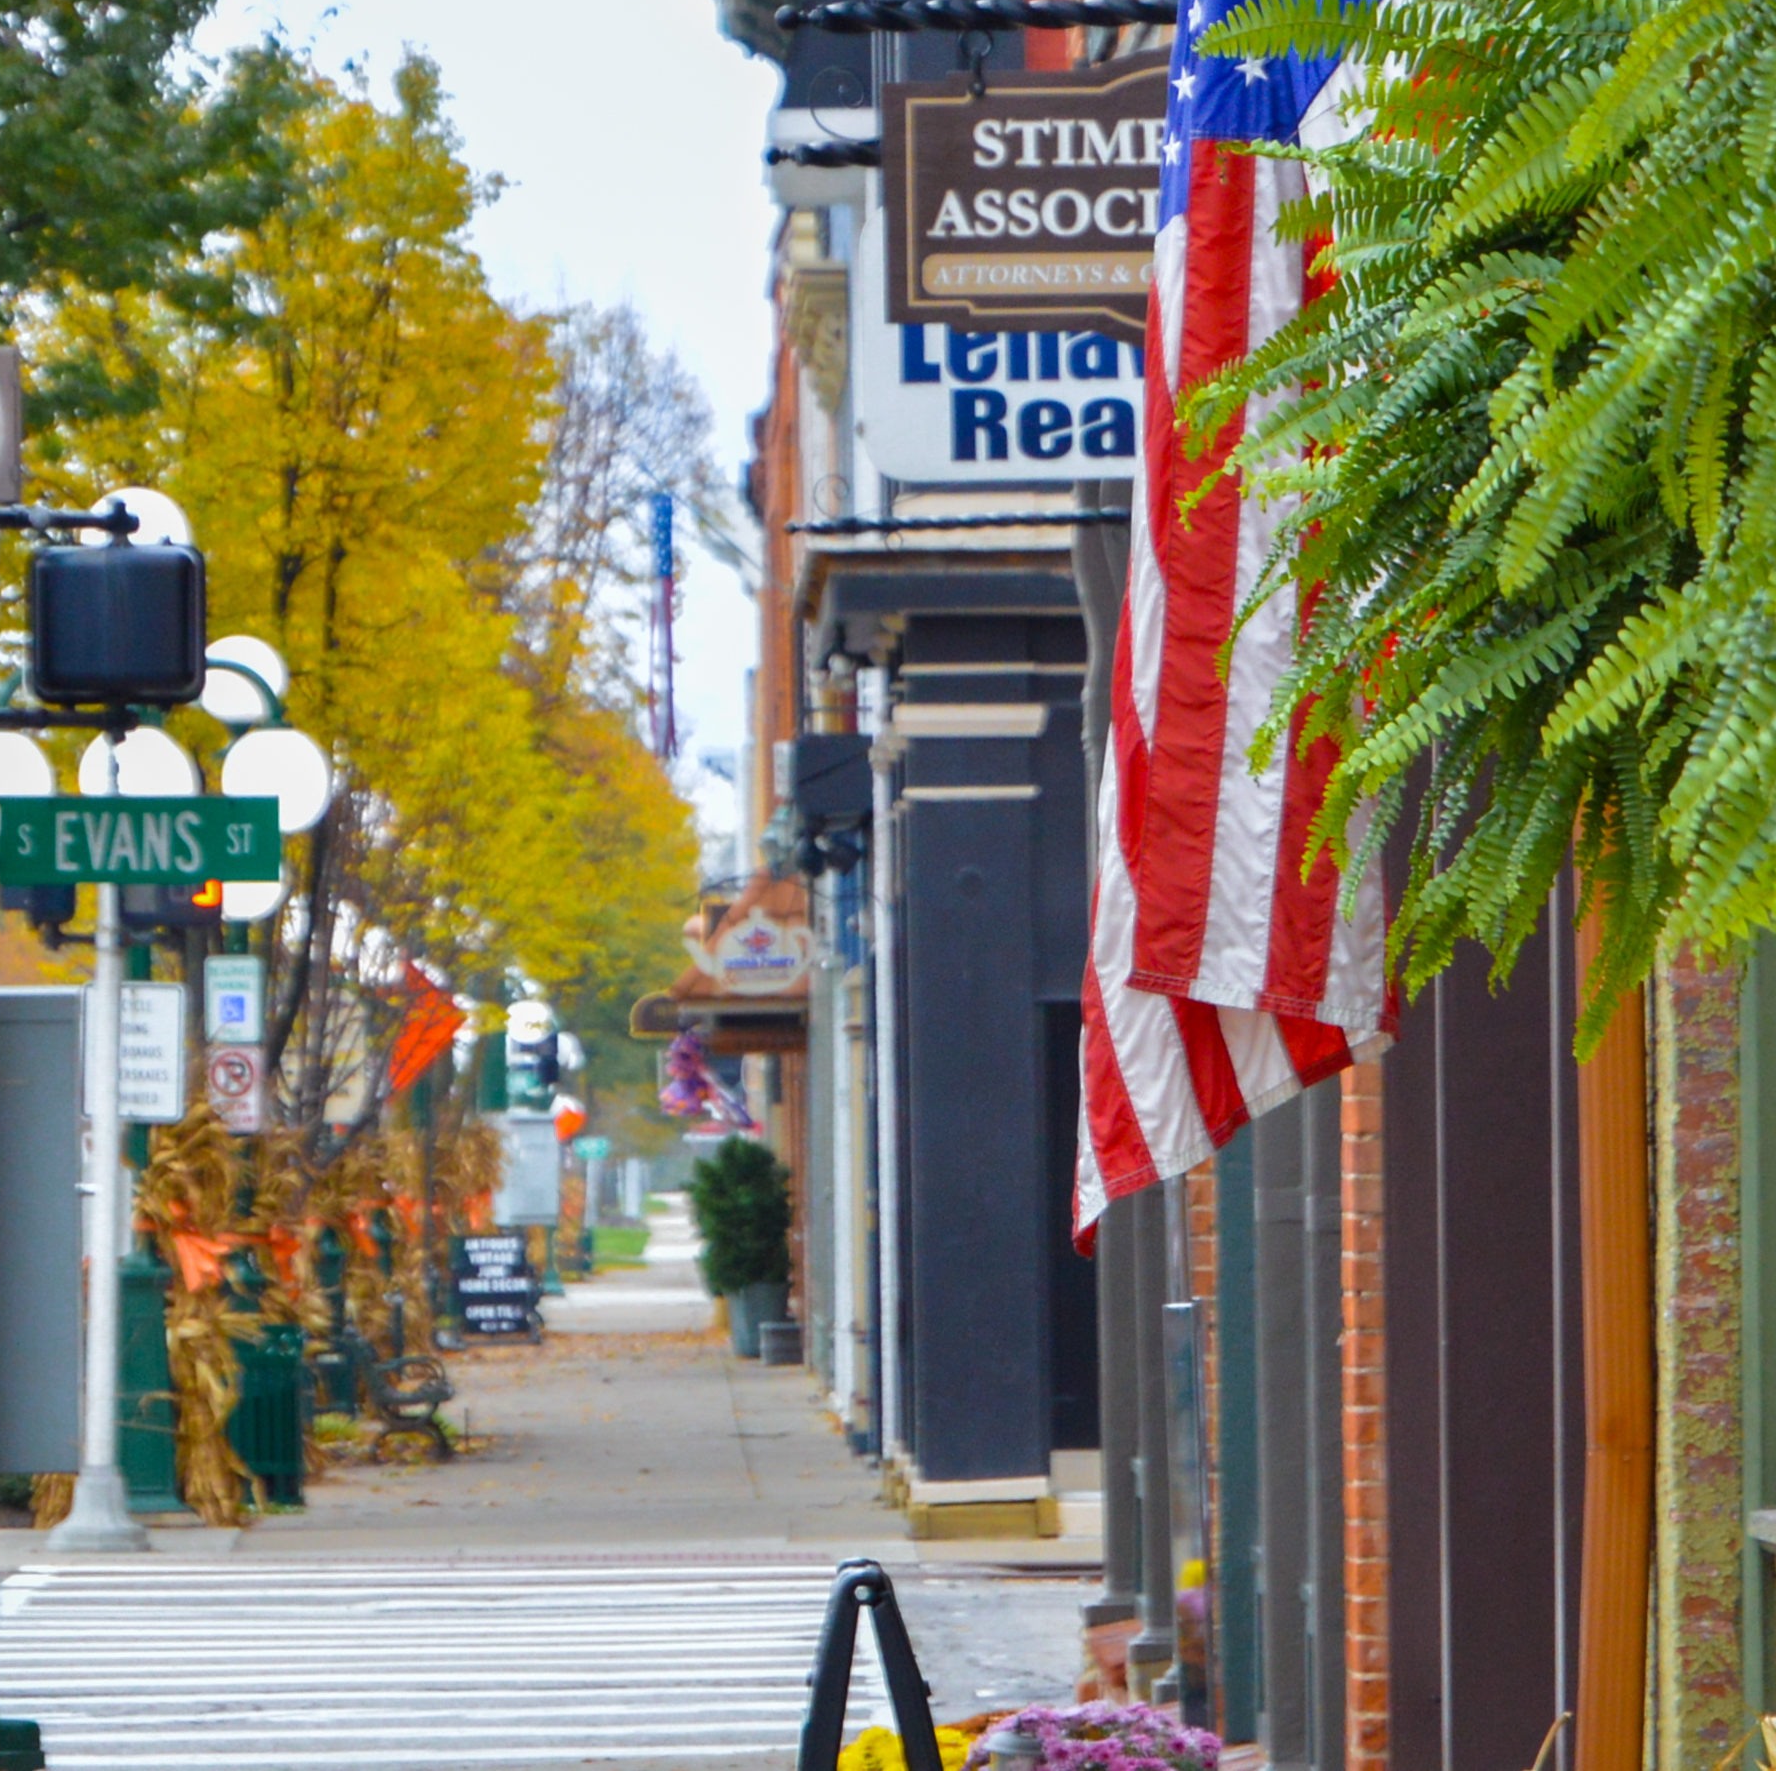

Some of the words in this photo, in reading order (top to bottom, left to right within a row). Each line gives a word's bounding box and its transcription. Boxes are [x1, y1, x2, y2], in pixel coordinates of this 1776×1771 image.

[933, 263, 1104, 286] ATTORNEYS
[1109, 263, 1133, 286] &
[950, 387, 1136, 461] Rea
[17, 823, 33, 856] S
[55, 810, 204, 873] EVANS
[226, 823, 253, 856] ST
